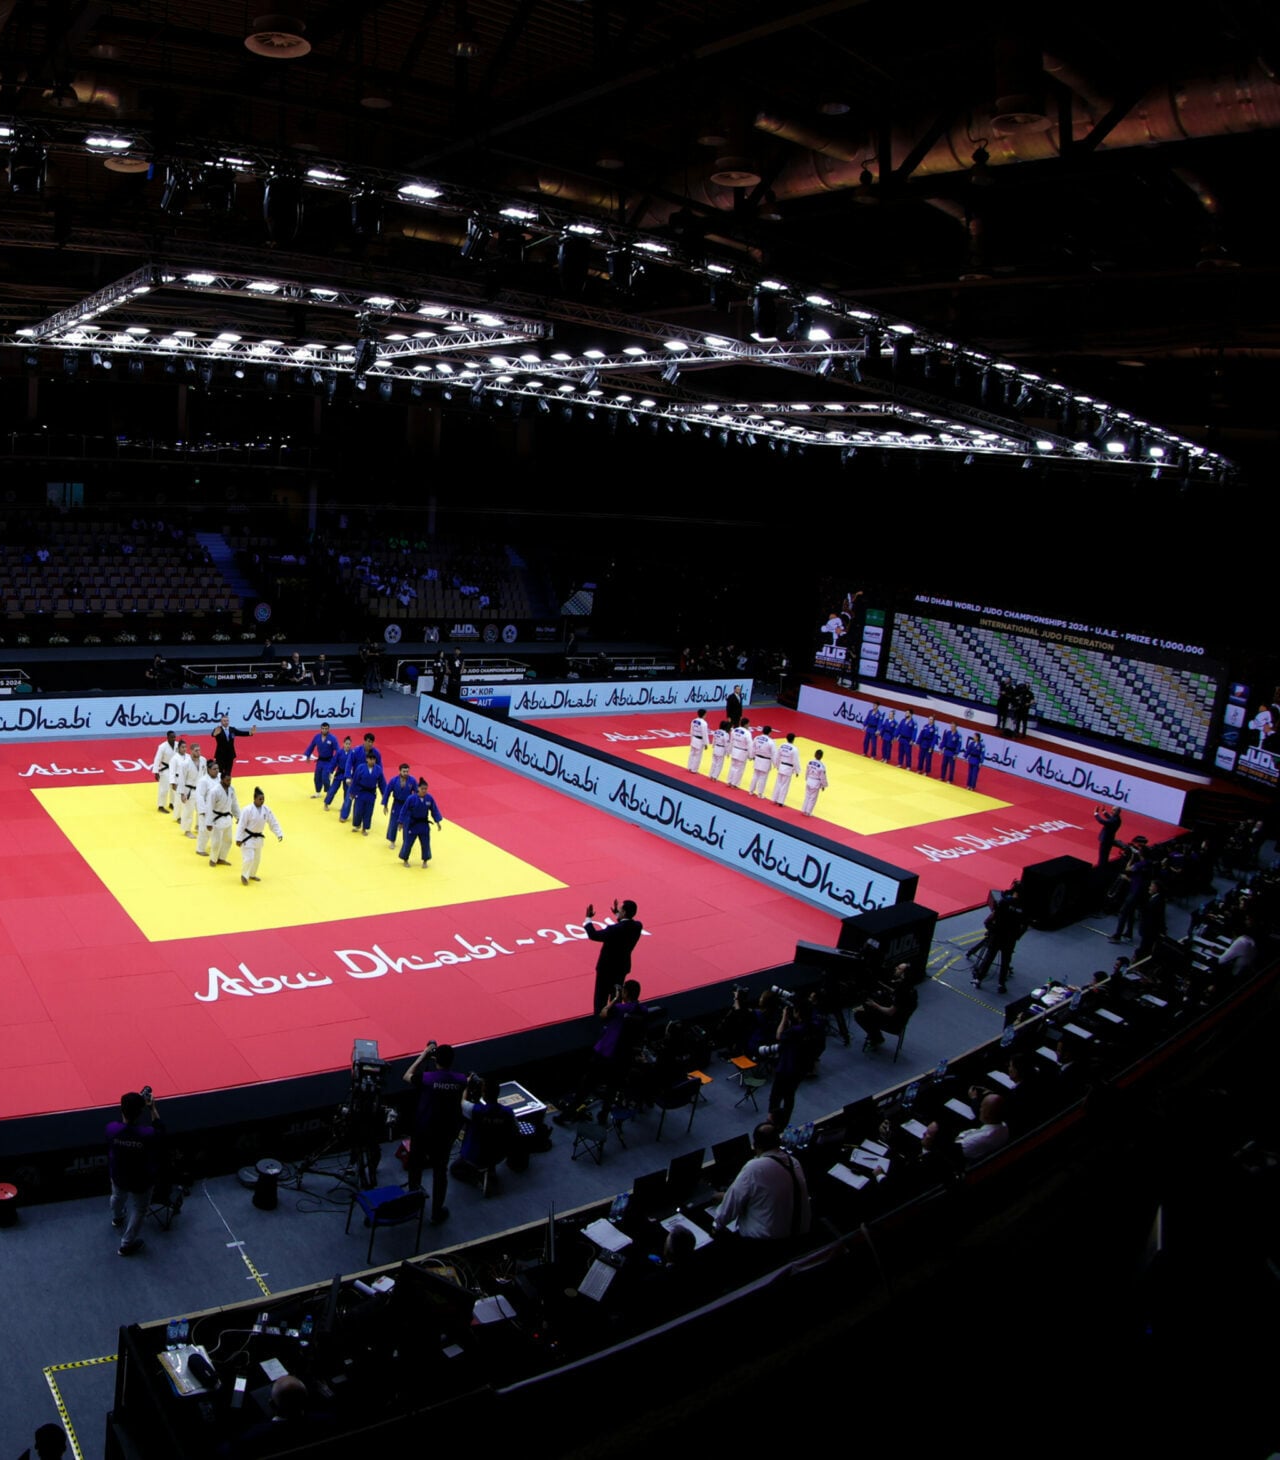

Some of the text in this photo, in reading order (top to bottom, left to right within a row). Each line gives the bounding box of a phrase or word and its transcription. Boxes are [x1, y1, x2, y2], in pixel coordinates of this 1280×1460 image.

[915, 595, 1204, 655] ABU DHABI WORLD JUDO CHAMPIONSHIPS 2024 U.A.E. PRIZE € 1,000,000
[980, 618, 1114, 651] INTERNATIONAL JUDO FEDERATION
[18, 762, 104, 777] Abu
[193, 963, 333, 1002] Abu
[334, 933, 515, 979] Dhabi
